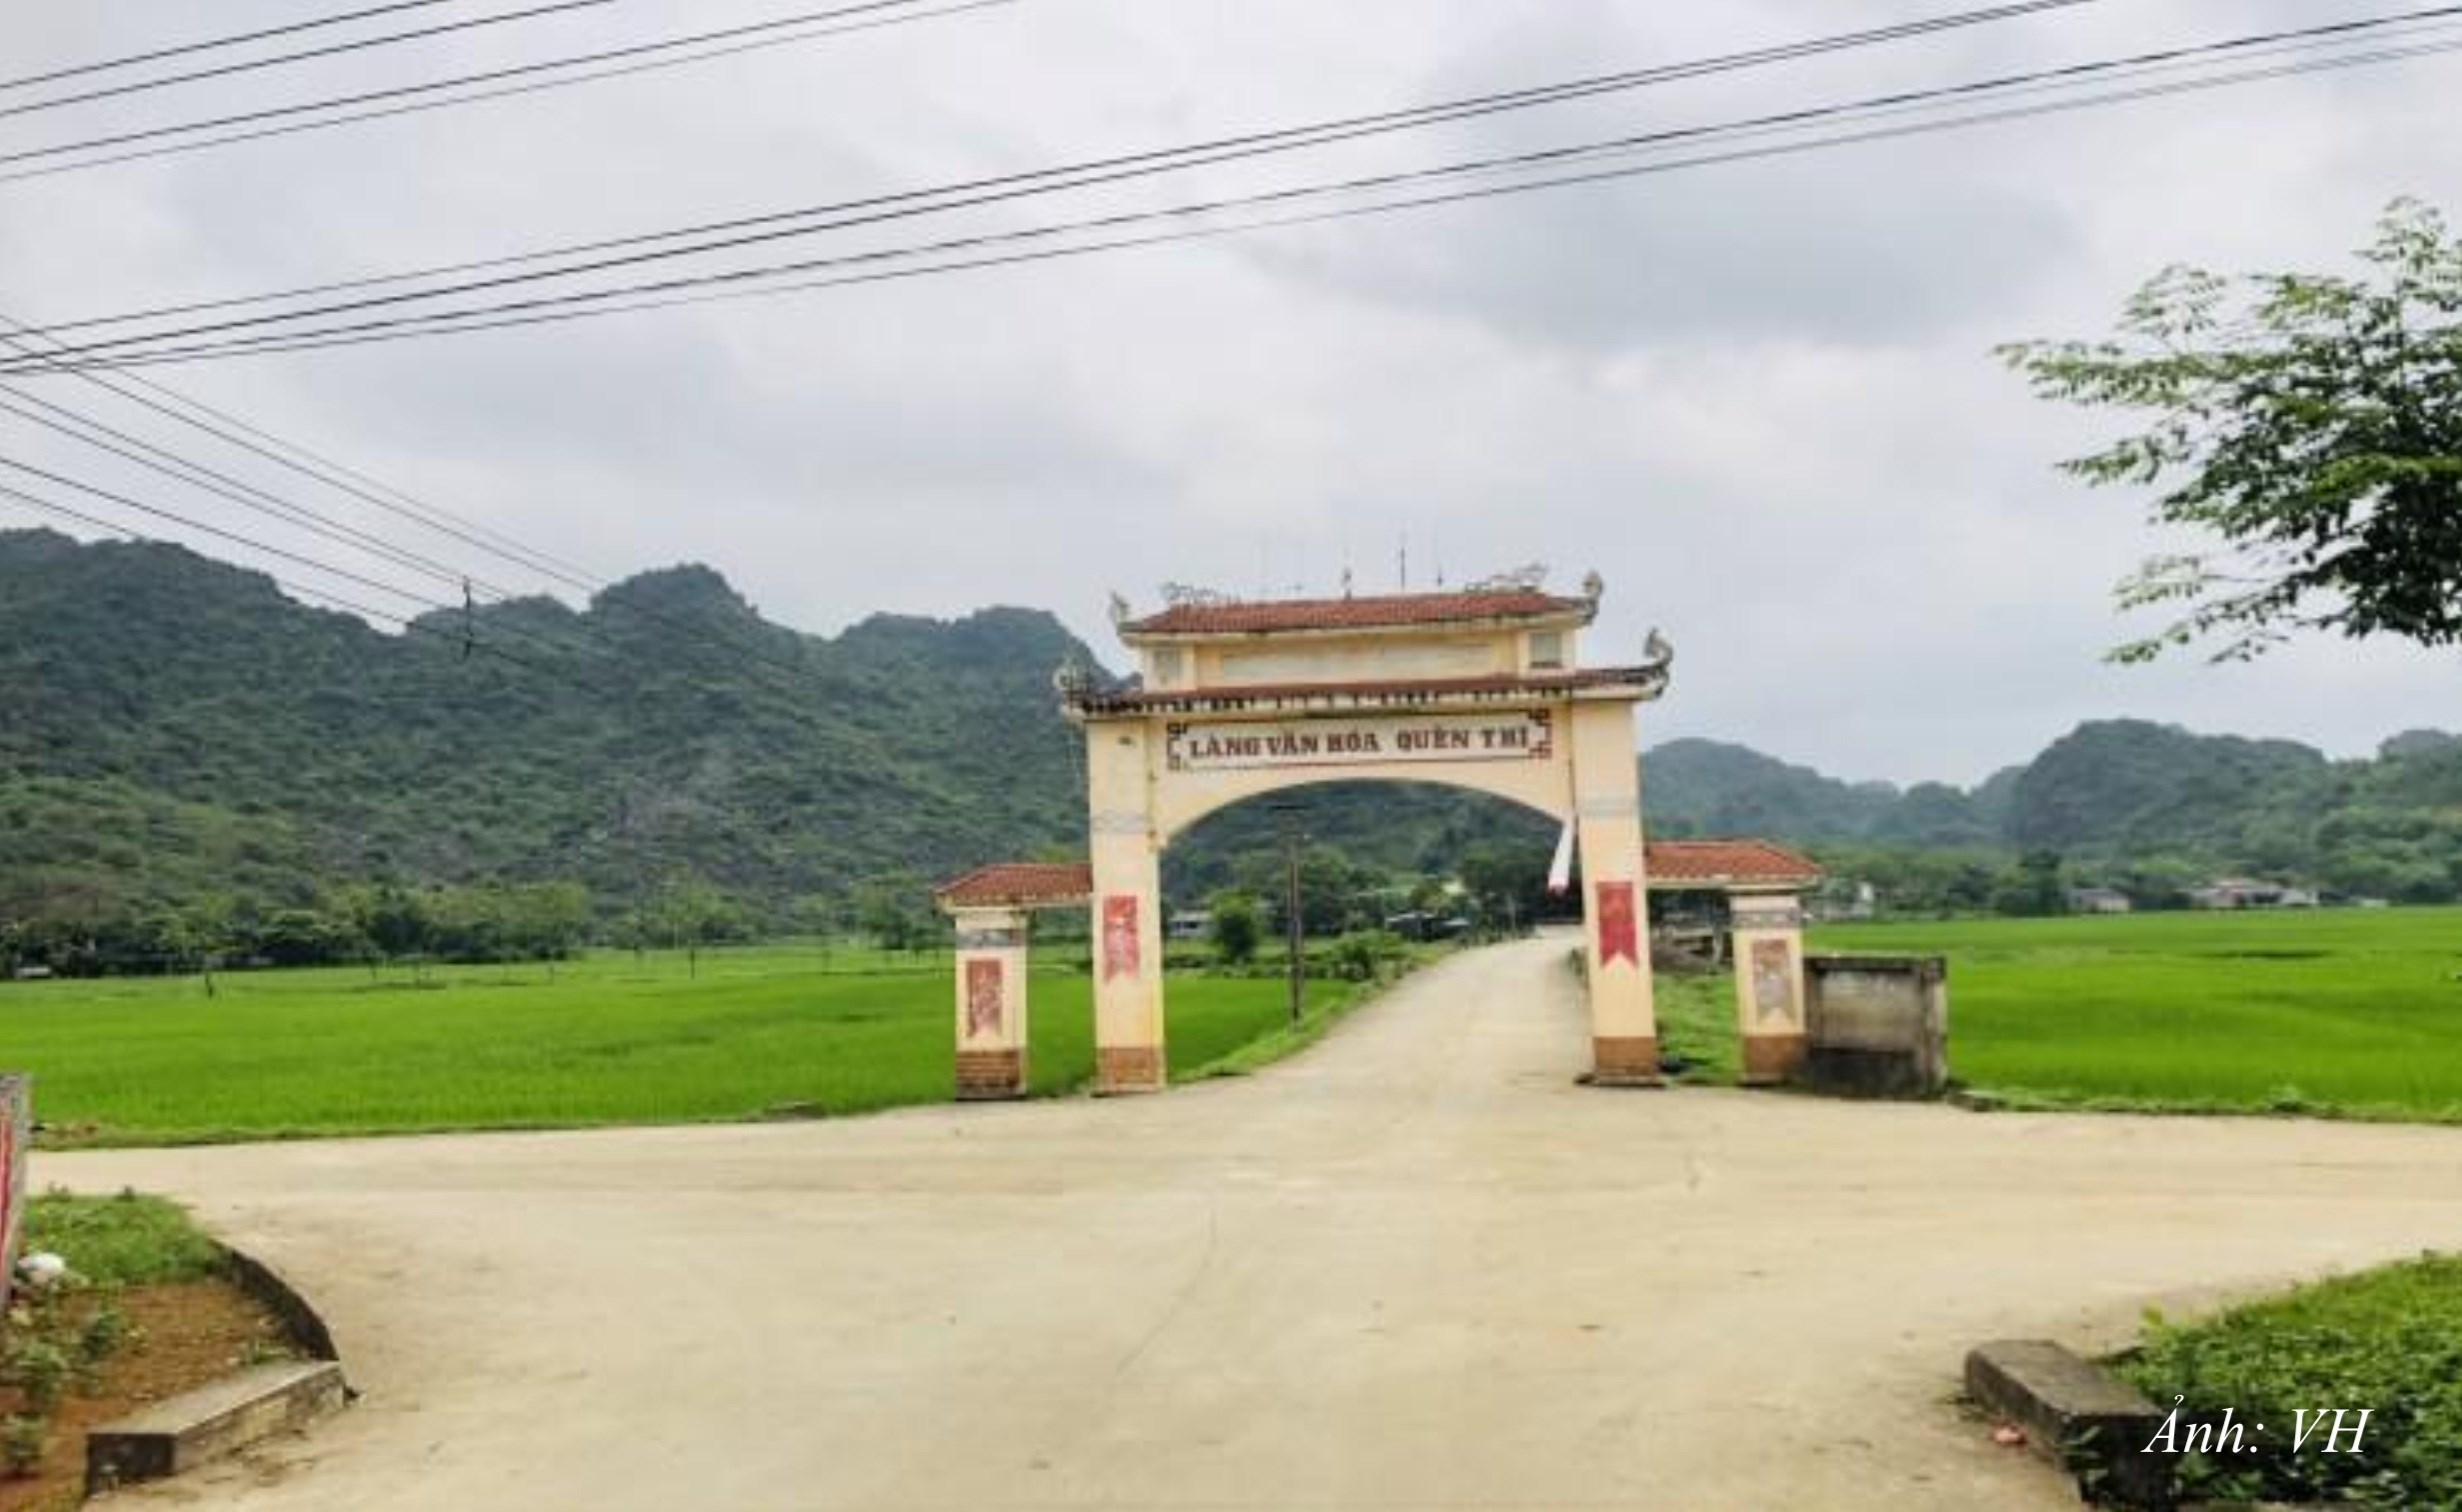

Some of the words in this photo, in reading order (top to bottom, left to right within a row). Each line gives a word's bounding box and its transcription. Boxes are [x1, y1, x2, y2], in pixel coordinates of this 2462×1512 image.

[1189, 732, 1260, 758] LÀNG
[1265, 729, 1319, 756] VĂN
[1326, 728, 1381, 753] HÓA
